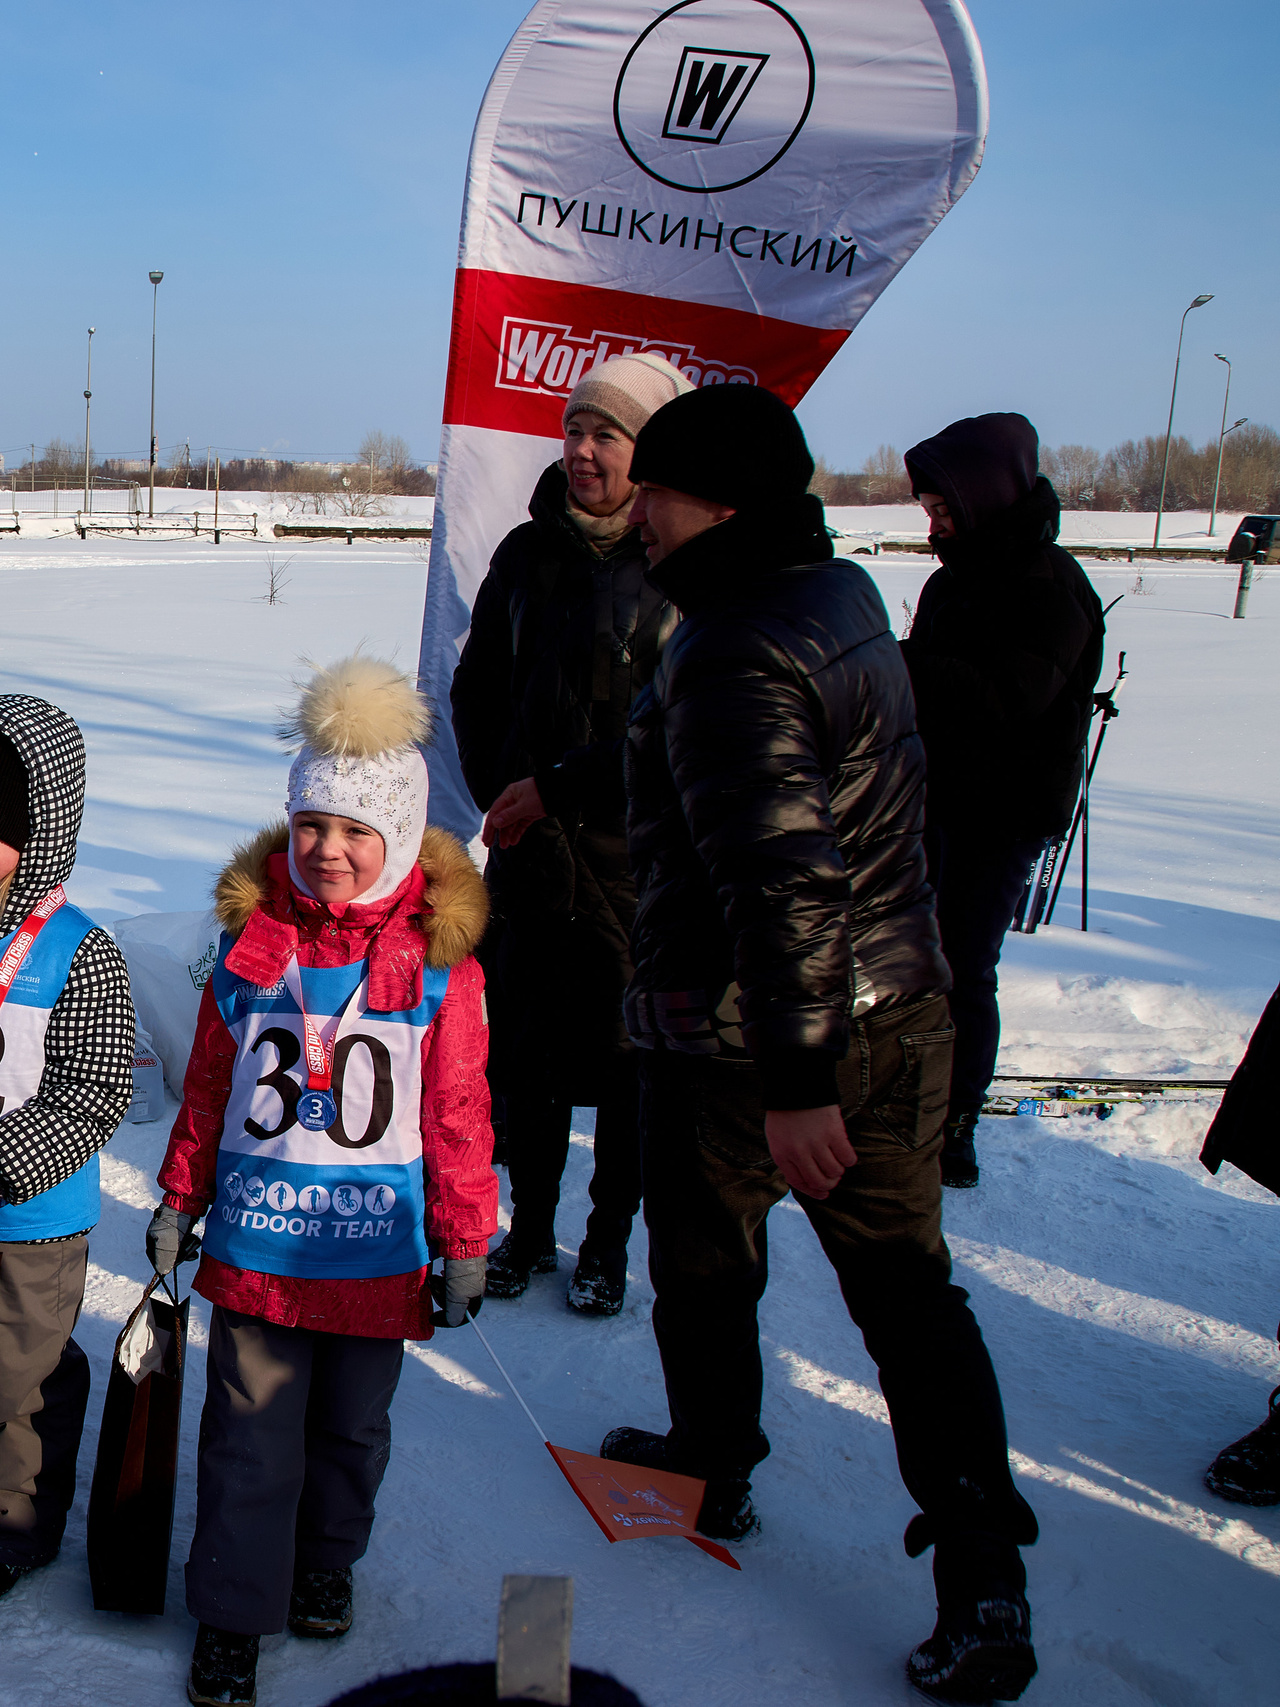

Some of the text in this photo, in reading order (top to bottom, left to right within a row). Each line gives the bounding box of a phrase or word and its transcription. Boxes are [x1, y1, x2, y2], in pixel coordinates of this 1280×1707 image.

[516, 192, 858, 278] ПУШКИНСКИЙ
[1041, 845, 1057, 888] salomon
[10, 934, 31, 959] Class
[309, 1045, 323, 1072] Class
[244, 1026, 394, 1149] 30
[310, 1099, 323, 1119] 3
[222, 1204, 395, 1239] OUTDOOR TEAM
